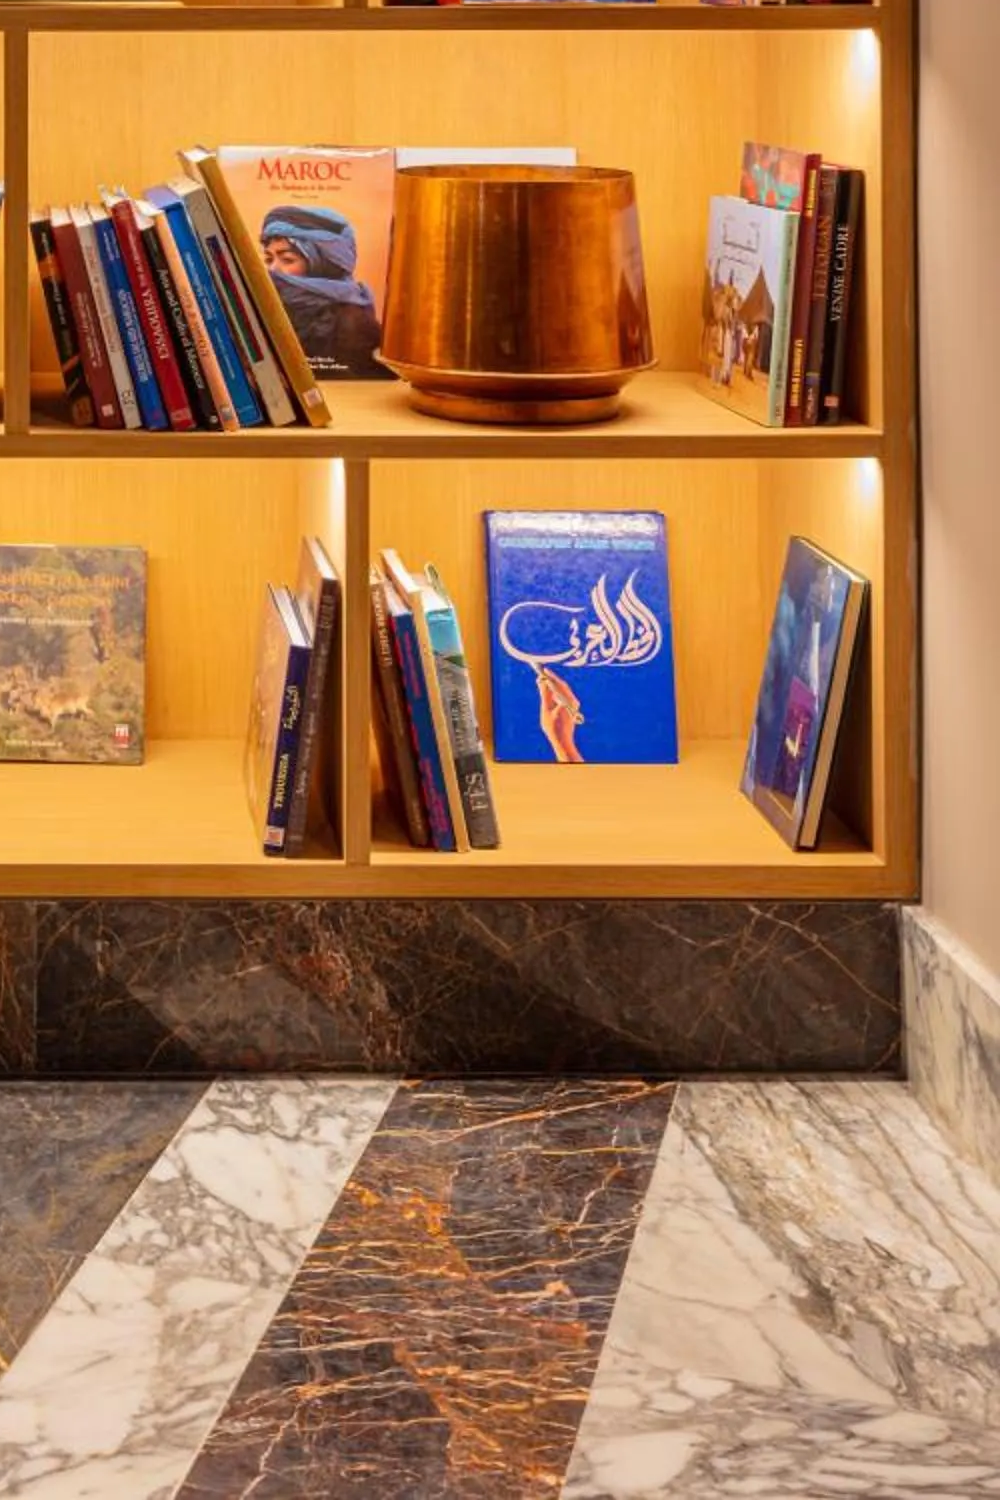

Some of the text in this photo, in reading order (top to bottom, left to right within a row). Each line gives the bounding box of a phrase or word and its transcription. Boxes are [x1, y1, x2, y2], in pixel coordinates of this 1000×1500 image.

[257, 157, 352, 181] MAROC
[828, 223, 849, 321] VENISE CADRE
[140, 287, 170, 359] ESSAOUIRA
[460, 771, 489, 812] FÈS
